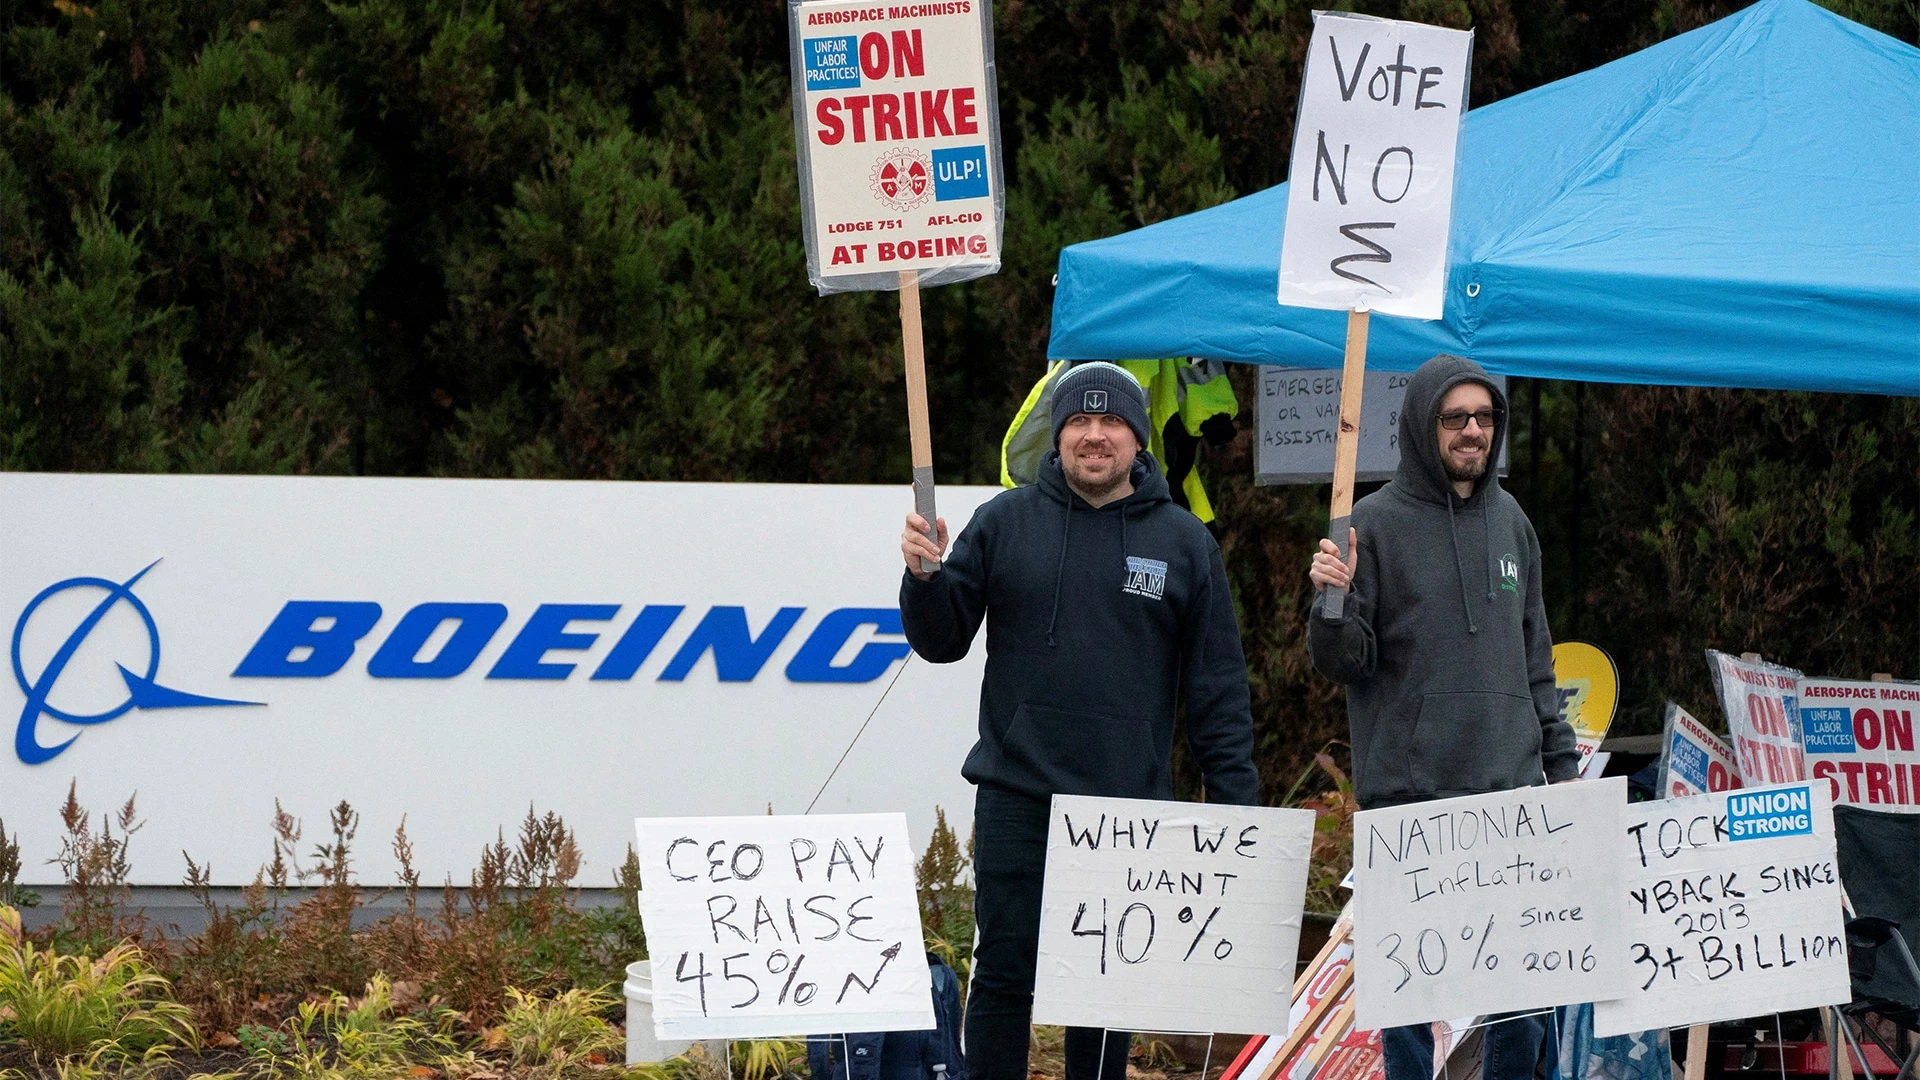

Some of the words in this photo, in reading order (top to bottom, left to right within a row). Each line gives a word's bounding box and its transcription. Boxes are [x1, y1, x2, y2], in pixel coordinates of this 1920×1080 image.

[807, 8, 885, 26] AEROSPACE
[888, 1, 971, 20] MACHINISTS
[814, 39, 848, 53] UNFAIR
[816, 53, 847, 67] LABOR
[859, 28, 925, 81] ON
[807, 66, 858, 82] PRACTICES!
[816, 87, 978, 146] STRIKE
[938, 158, 982, 182] ULP!
[828, 221, 874, 234] LODGE
[878, 219, 903, 230] 751
[927, 212, 983, 226] AFL-CIO
[831, 244, 868, 266] AT
[878, 234, 988, 262] BOEING
[1278, 407, 1301, 420] OR
[231, 601, 912, 684] BOEING
[1804, 686, 1876, 699] AEROSPACE
[1880, 688, 1920, 702] MACHI
[1747, 693, 1789, 739] ON
[1811, 710, 1842, 721] UNFAIR
[1813, 722, 1842, 733] LABOR
[1853, 707, 1915, 751] ON
[1680, 715, 1730, 761] AEROSPACE
[1680, 738, 1702, 761] UNFAIR
[1805, 734, 1854, 746] PRACTICES!
[1680, 747, 1700, 771] LABOR
[1813, 760, 1920, 806] STRI
[1731, 790, 1808, 817] UNION
[1064, 813, 1160, 850] WHY
[1193, 825, 1259, 859] WE
[1368, 804, 1574, 869] NATIONAL
[1732, 814, 1809, 836] STRONG
[666, 836, 764, 882] CEO
[789, 836, 884, 883] PAY
[1127, 867, 1238, 896] WANT
[1760, 862, 1835, 893] SINCE
[707, 894, 884, 944] RAISE
[1674, 903, 1751, 937] 2013
[1522, 944, 1597, 972] 2016
[676, 949, 819, 1018] 45%
